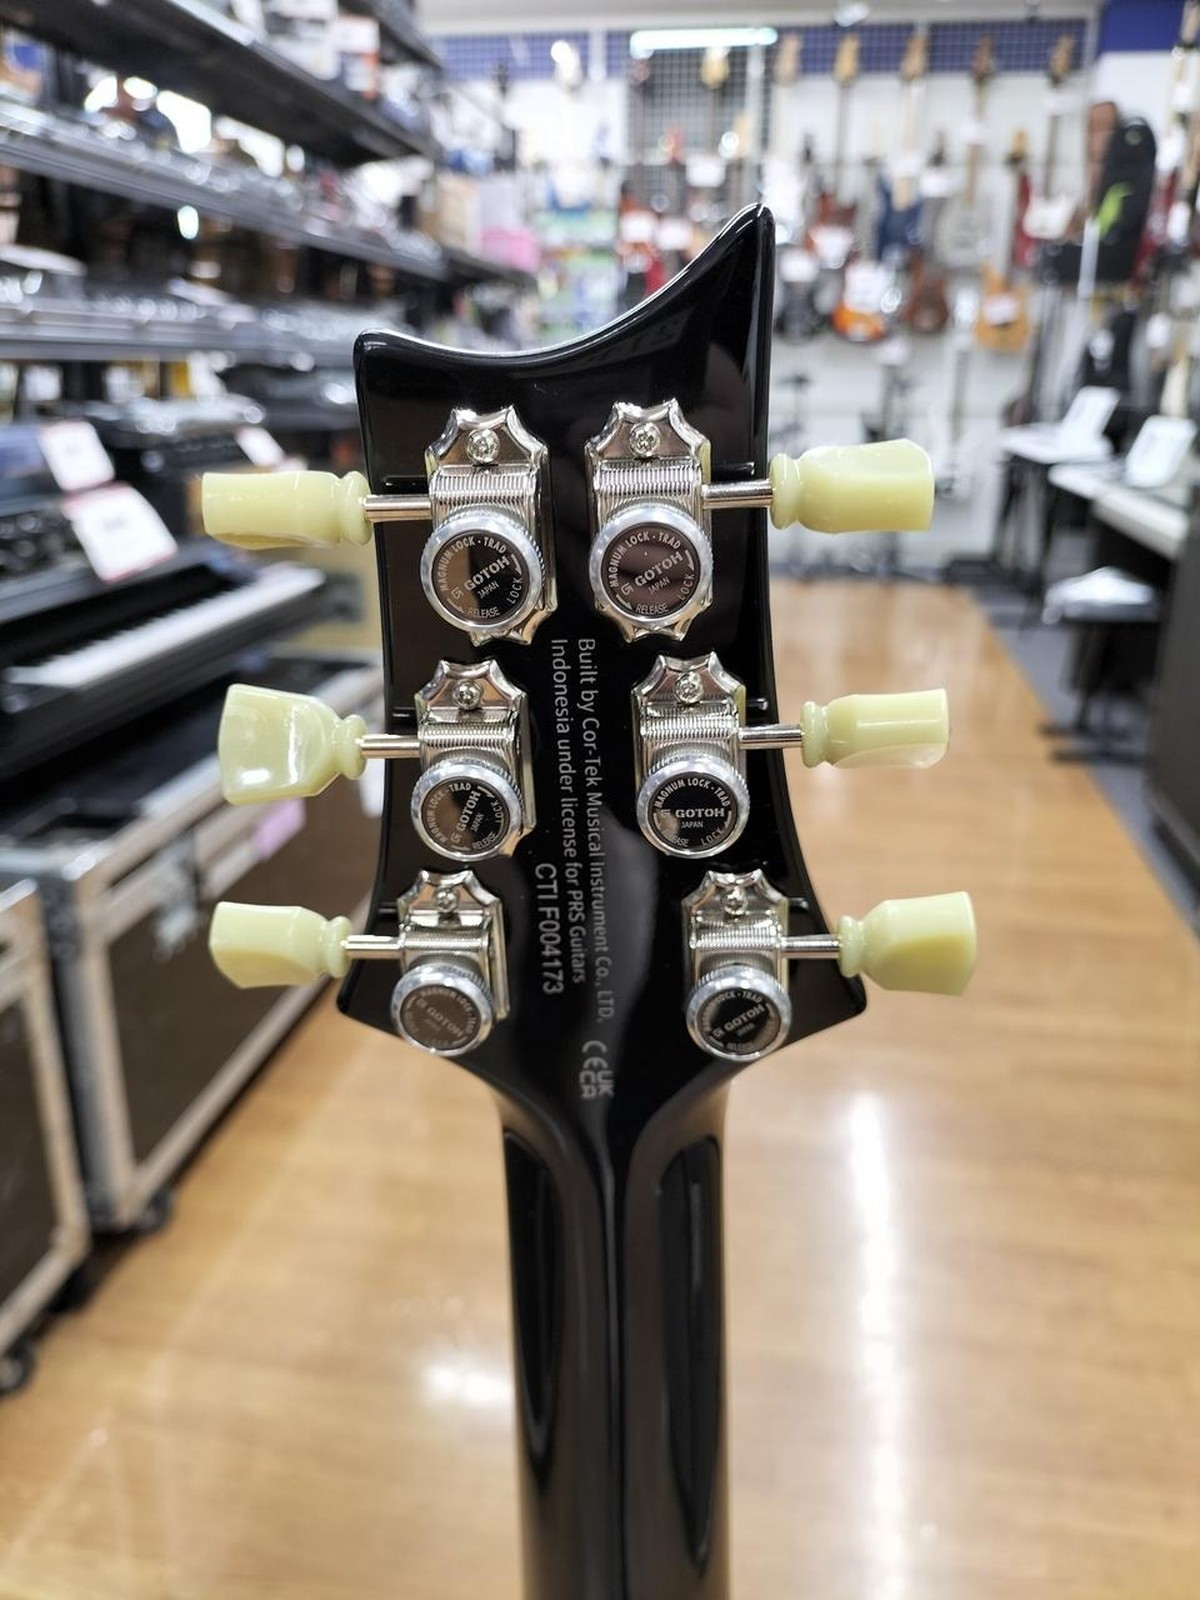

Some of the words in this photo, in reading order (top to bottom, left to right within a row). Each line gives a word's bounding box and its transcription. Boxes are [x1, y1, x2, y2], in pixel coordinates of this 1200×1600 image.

[451, 536, 476, 553] LOCK
[483, 537, 507, 554] TRAD
[608, 546, 628, 588] MAGNUM
[625, 531, 650, 548] LOCK
[658, 532, 681, 550] TRAD
[463, 555, 511, 591] GOTOH
[634, 551, 684, 587] GOTOH
[648, 576, 671, 595] JAPAN
[477, 580, 500, 599] JAPAN
[506, 577, 522, 605] LOCK
[679, 573, 695, 601] LOCK
[468, 606, 501, 619] RELEASE
[635, 602, 669, 615] RELEASE
[577, 638, 598, 684] Built
[551, 639, 574, 735] Indonesia
[577, 690, 599, 713] by
[557, 739, 577, 791] under
[582, 717, 603, 787] Cor-Tek
[449, 782, 472, 793] TRAD
[654, 779, 686, 809] MAGNUM
[687, 778, 711, 789] LOCK
[714, 786, 731, 807] TRAD
[456, 790, 481, 832] GOTOH
[560, 798, 579, 858] license
[586, 792, 606, 858] Musical
[675, 808, 725, 819] GOTOH
[681, 820, 704, 829] JAPAN
[535, 862, 559, 900] CTI
[565, 862, 583, 887] for
[566, 889, 586, 923] PRS
[589, 862, 609, 952] Instrument
[537, 907, 565, 995] F004173
[569, 925, 588, 984] Guitars
[724, 1004, 766, 1032] GOTOH
